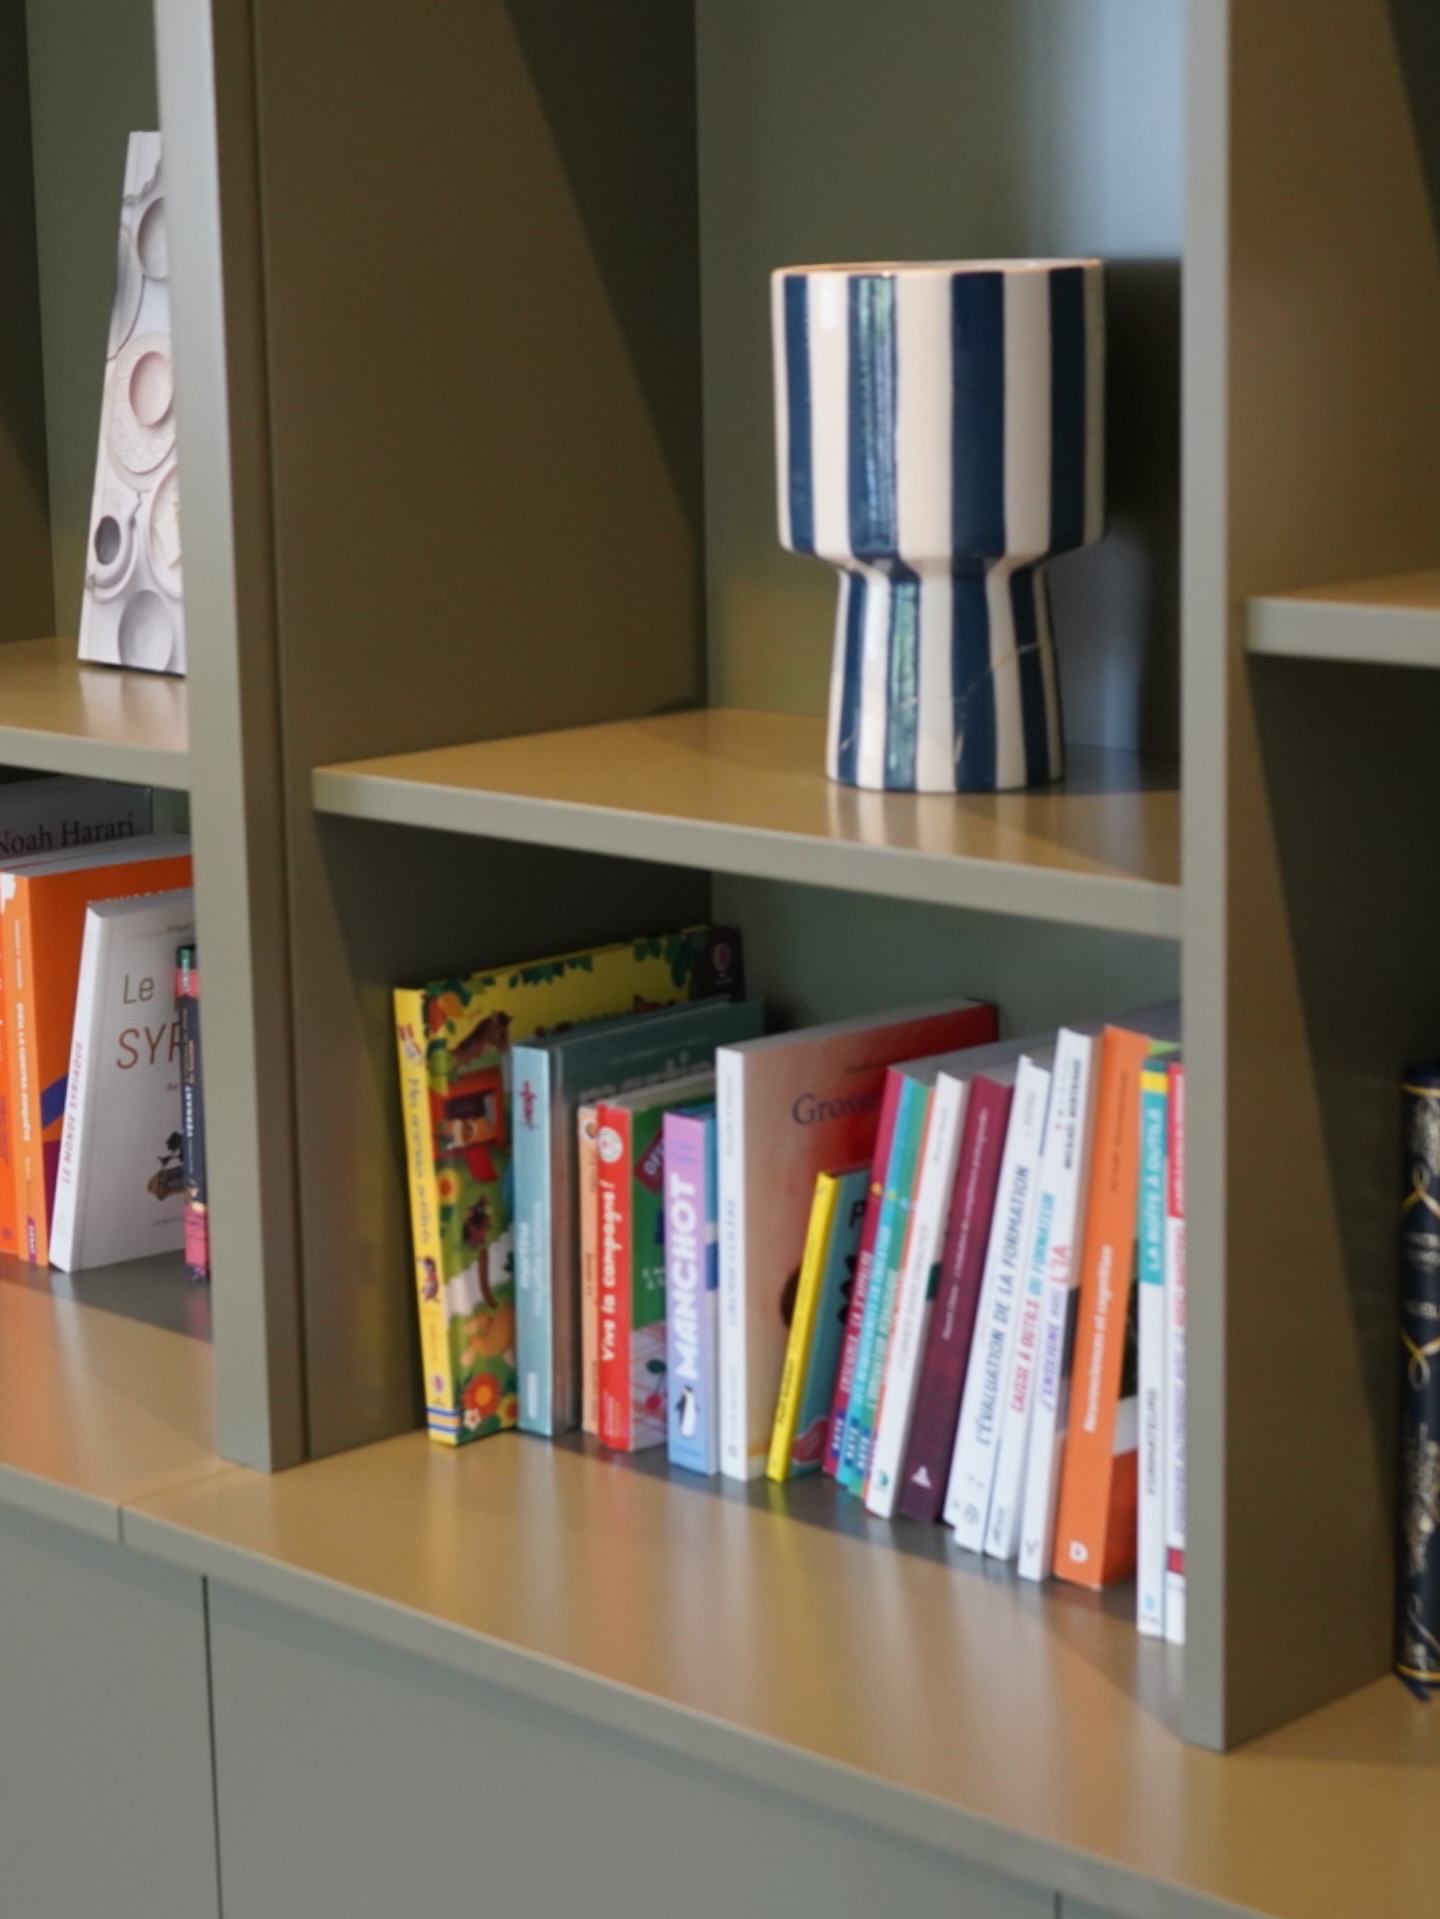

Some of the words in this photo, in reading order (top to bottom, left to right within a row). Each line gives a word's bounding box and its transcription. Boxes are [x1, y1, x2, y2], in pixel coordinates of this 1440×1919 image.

[61, 812, 135, 847] Harari
[123, 974, 155, 1004] Le
[69, 1041, 84, 1110] SYRIAQUE
[184, 1085, 195, 1138] VERNANT
[63, 1115, 77, 1164] MONDE
[1146, 1107, 1164, 1168] OUTILS
[1146, 1172, 1162, 1190] À
[1001, 1163, 1030, 1268] FORMATION
[1033, 1192, 1056, 1274] FORMATEUR
[1146, 1193, 1162, 1242] BOÎTE
[669, 1171, 699, 1381] MANCHOT
[1049, 1244, 1071, 1285] L'IA
[1096, 1244, 1114, 1312] cognition
[1146, 1243, 1162, 1272] LA
[602, 1294, 616, 1314] la
[998, 1272, 1014, 1297] LA
[1028, 1275, 1043, 1297] DU
[993, 1300, 1011, 1326] DE
[1020, 1299, 1040, 1350] OUTILS
[1094, 1314, 1107, 1331] et
[600, 1320, 616, 1361] Vive
[975, 1327, 1006, 1446] L'ÉVALUATION
[1009, 1365, 1032, 1413] CAISSE
[1040, 1323, 1060, 1413] J'ENSEIGNE
[1082, 1333, 1106, 1435] Neurosciences
